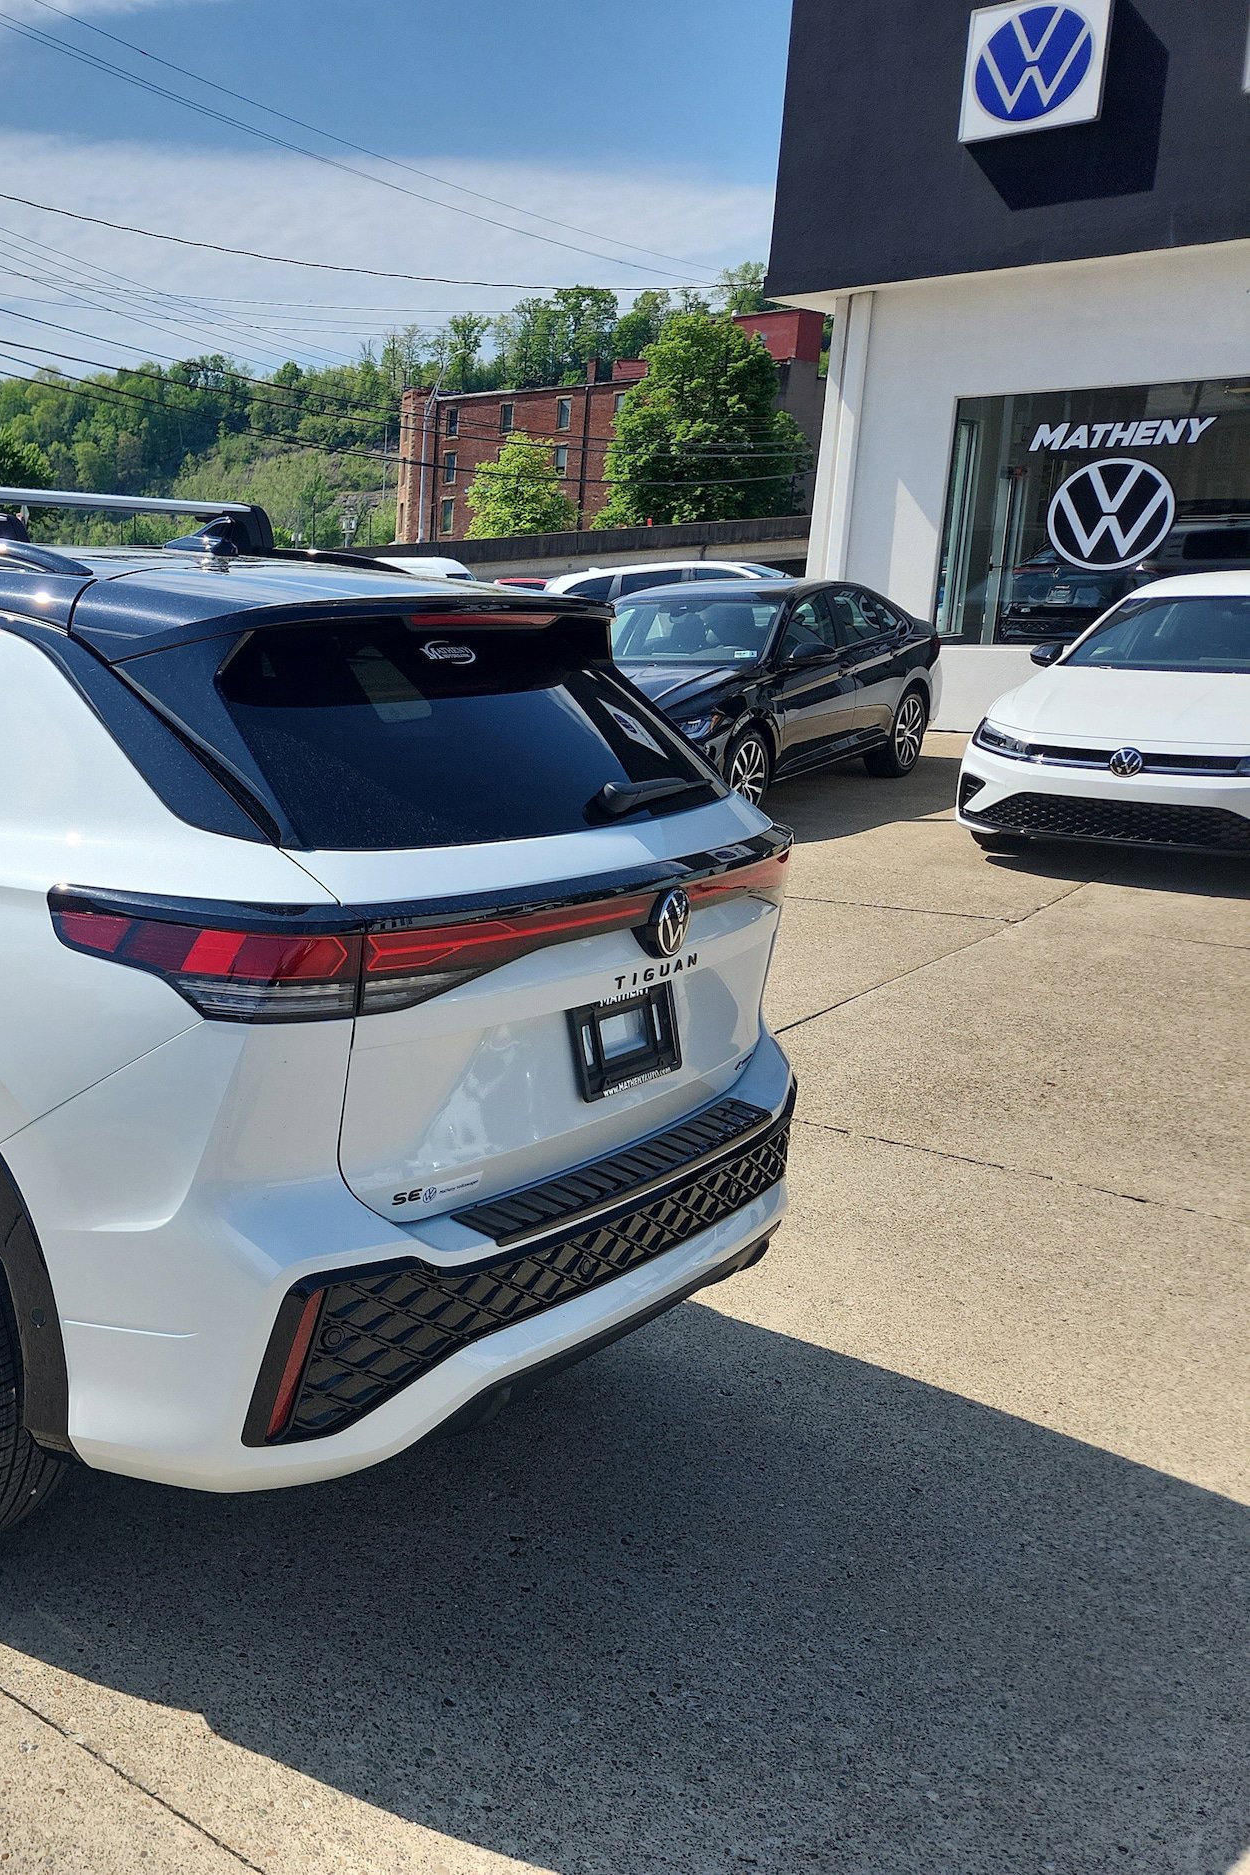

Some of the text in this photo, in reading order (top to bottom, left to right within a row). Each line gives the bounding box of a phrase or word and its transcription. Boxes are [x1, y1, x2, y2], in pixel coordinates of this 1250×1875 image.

[975, 4, 1092, 122] VW
[1028, 415, 1220, 452] MATHENY
[1048, 457, 1175, 570] VW
[1109, 747, 1143, 777] VW
[658, 888, 692, 957] VW
[614, 952, 699, 990] TIGUAN
[392, 1187, 423, 1206] SE
